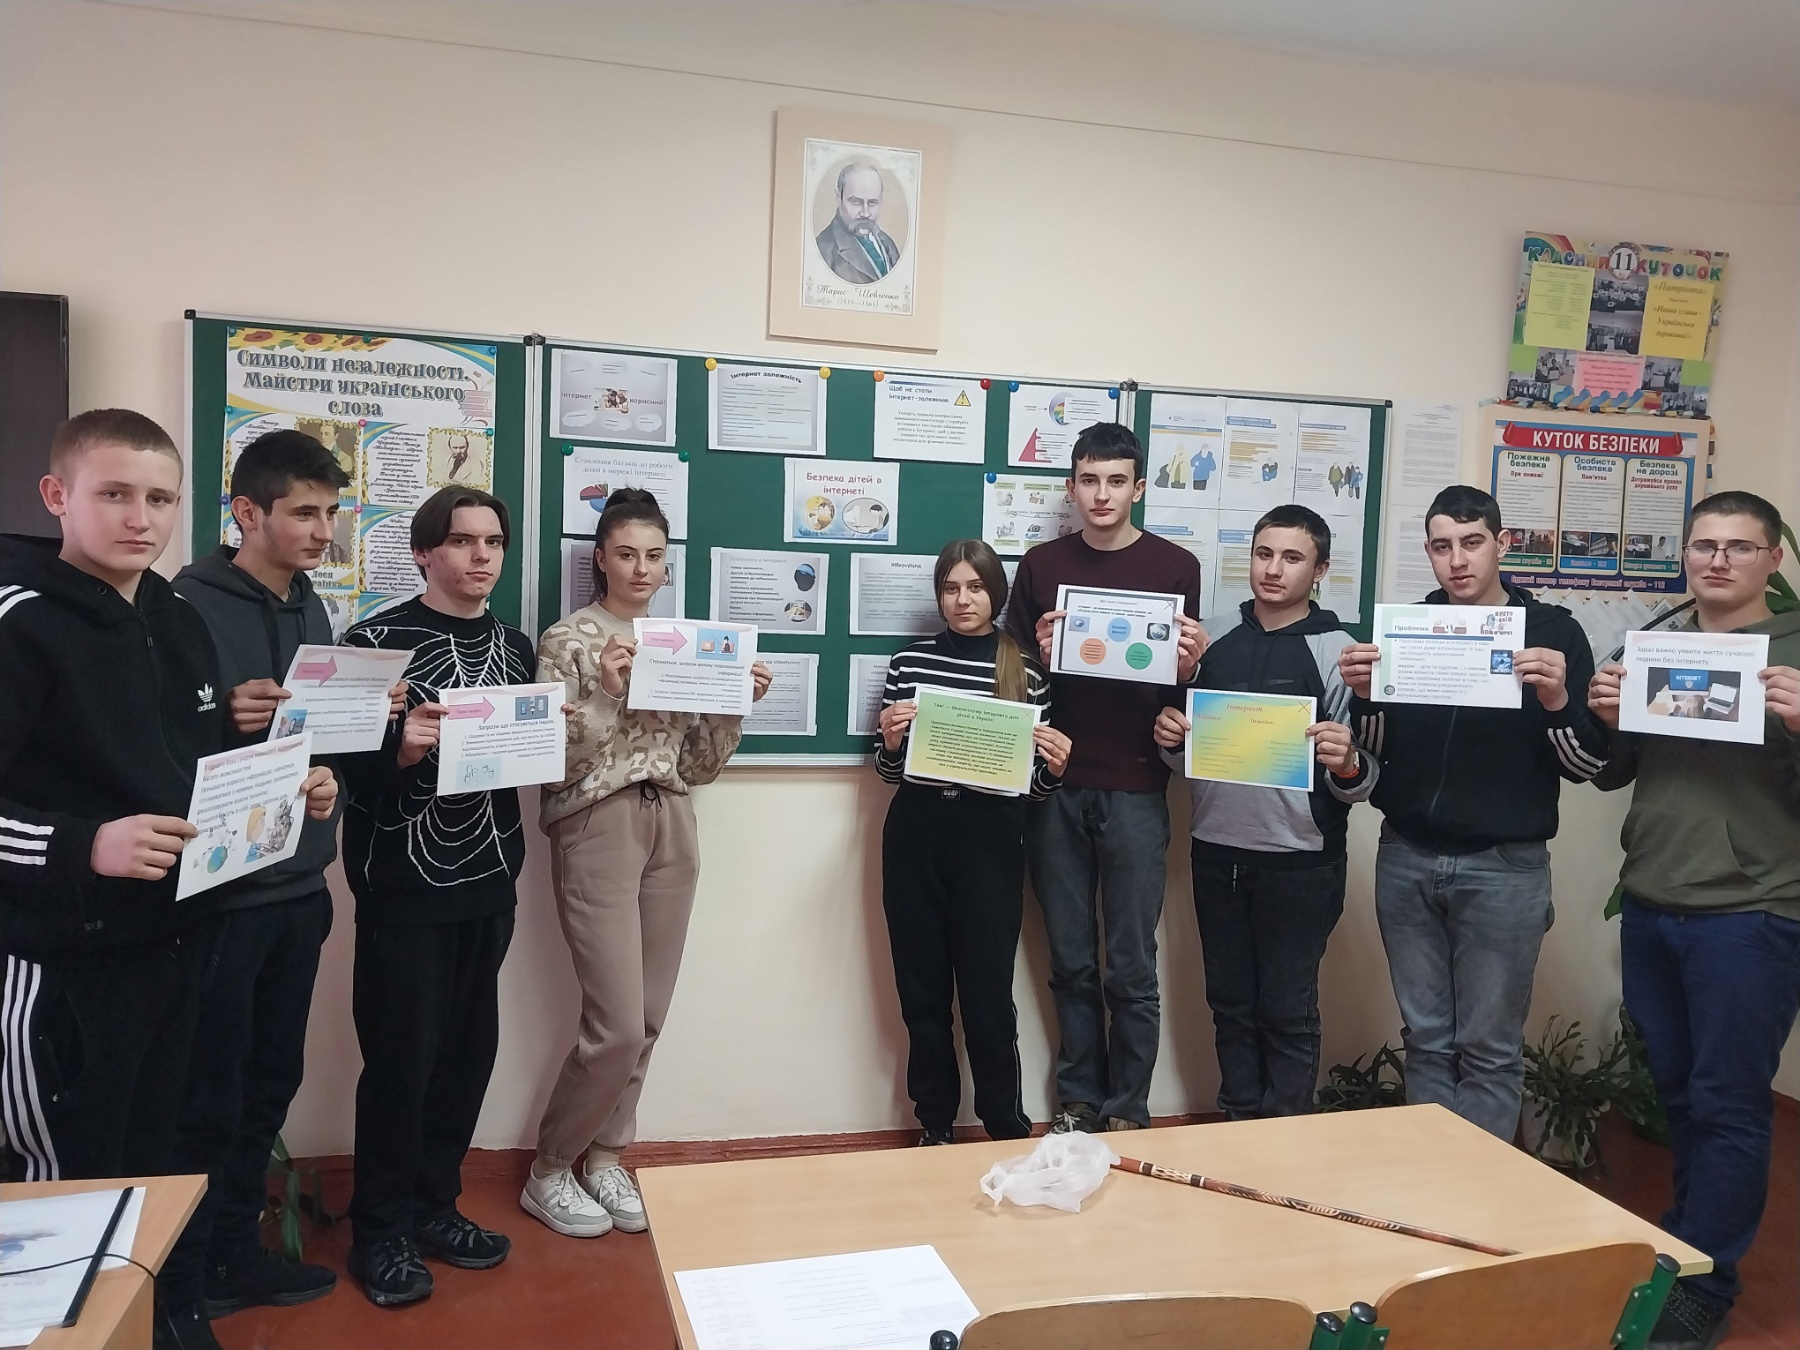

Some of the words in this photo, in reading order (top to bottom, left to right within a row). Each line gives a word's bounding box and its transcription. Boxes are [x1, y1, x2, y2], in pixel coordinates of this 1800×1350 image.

[1614, 252, 1633, 271] 11
[1636, 260, 1723, 281] КУТОЧОК
[817, 284, 847, 297] Тарас
[855, 287, 900, 301] Шевченко
[237, 349, 326, 372] Символи
[730, 372, 761, 380] Інтернет
[243, 371, 333, 394] Майстри
[338, 380, 466, 402] українського
[328, 401, 383, 417] слова
[1533, 431, 1584, 449] КУТОК
[1589, 434, 1660, 454] БЕЗПЕКИ
[575, 456, 612, 466] Ставлення
[648, 462, 673, 470] роботи
[1507, 452, 1550, 462] Пожежна
[1574, 456, 1616, 466] Особиста
[1510, 460, 1547, 469] безпека
[1577, 464, 1613, 473] безпека
[1640, 460, 1676, 469] Безпека
[806, 472, 844, 483] Безпека
[848, 475, 873, 484] дітей
[1649, 468, 1679, 477] дорозі
[824, 486, 865, 496] інтернеті
[197, 701, 217, 713] adidas
